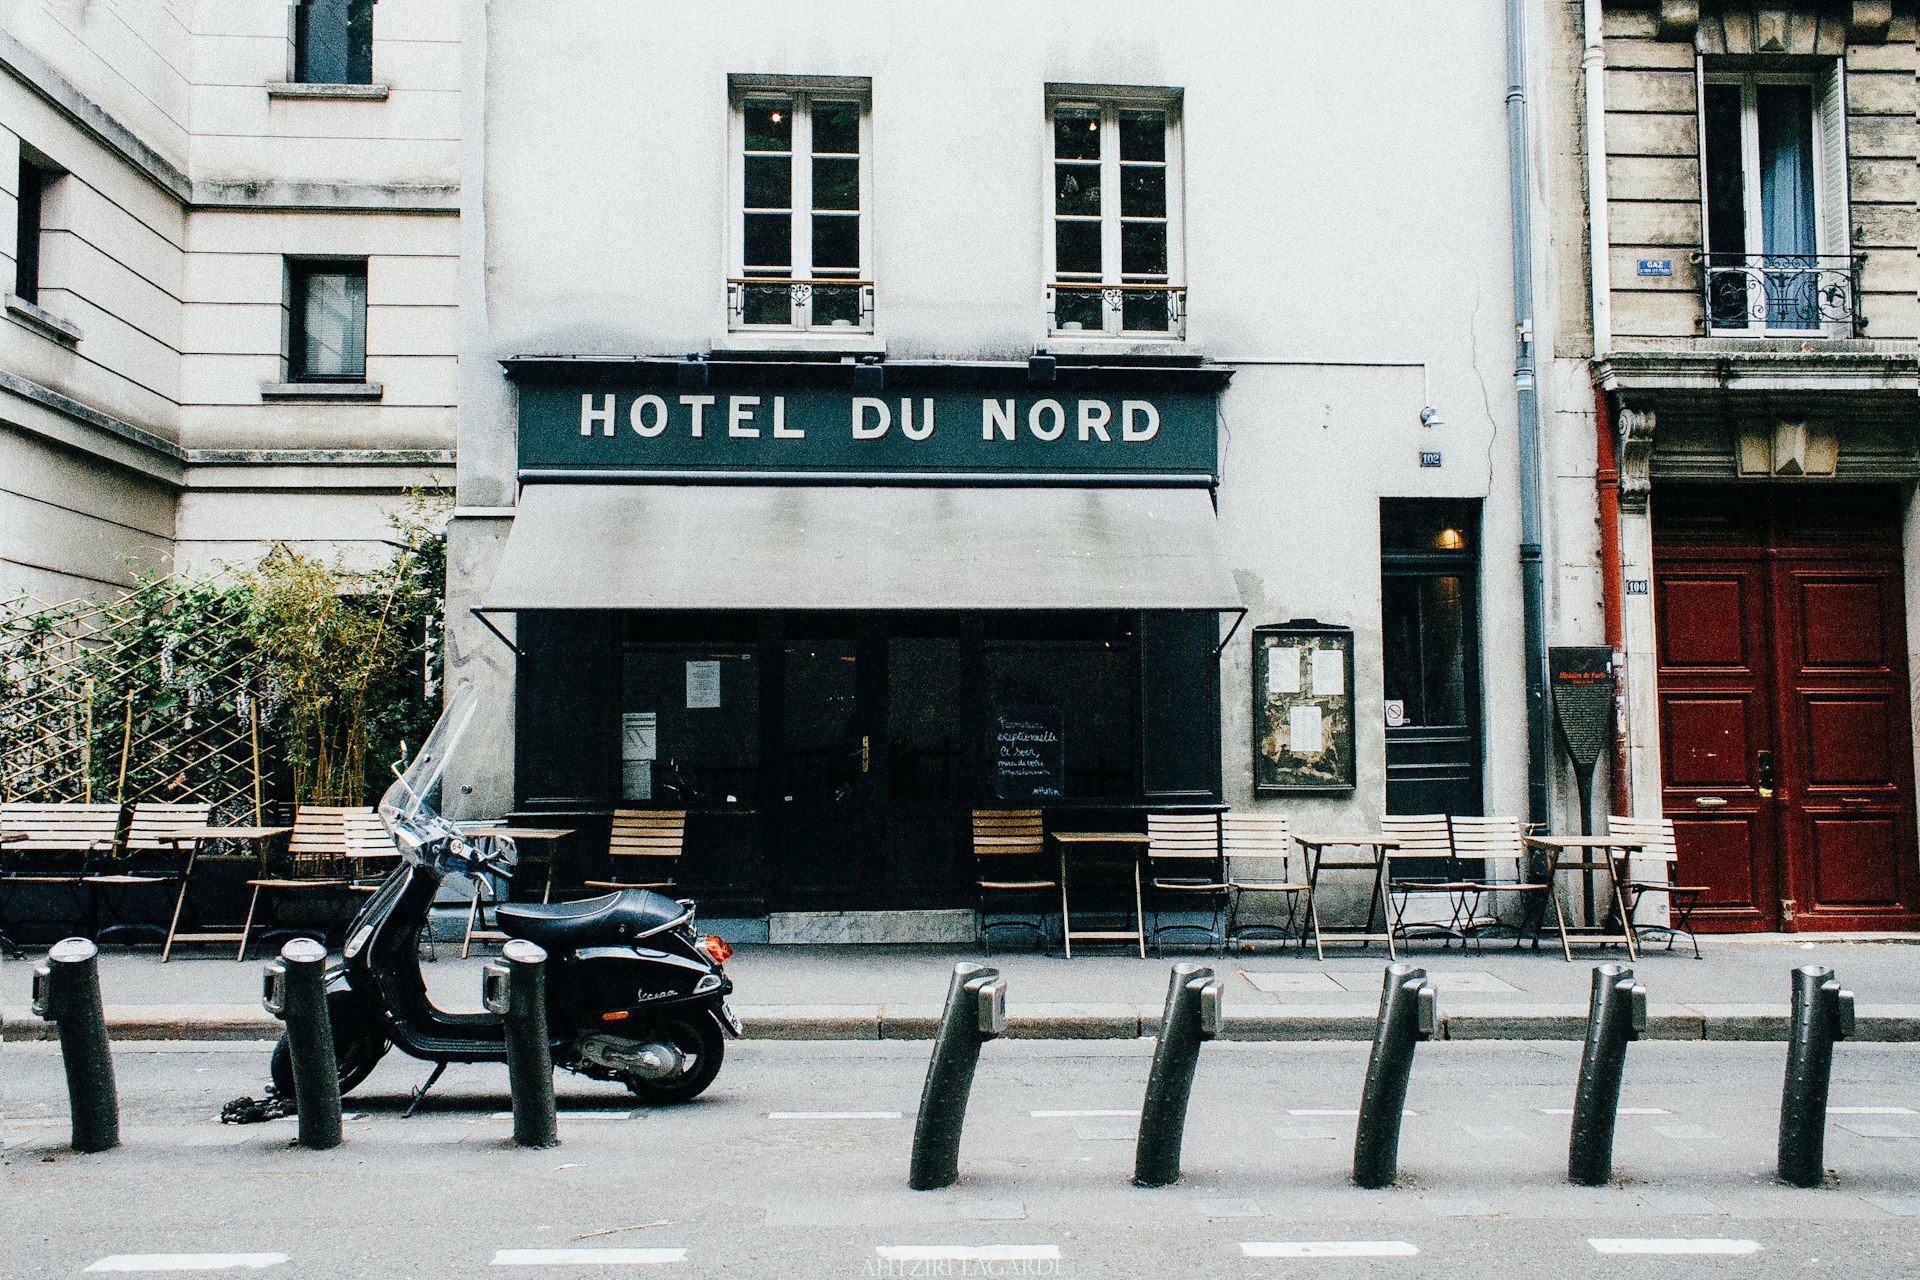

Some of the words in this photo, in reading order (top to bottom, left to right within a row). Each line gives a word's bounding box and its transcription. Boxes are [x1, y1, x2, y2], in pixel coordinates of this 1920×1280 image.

[1646, 260, 1664, 269] GAZ
[580, 393, 805, 438] HOTEL
[851, 396, 935, 441] DU
[982, 398, 1161, 442] NORD
[1422, 453, 1440, 464] 102
[1629, 581, 1646, 592] 100
[638, 988, 679, 1002] Vespa
